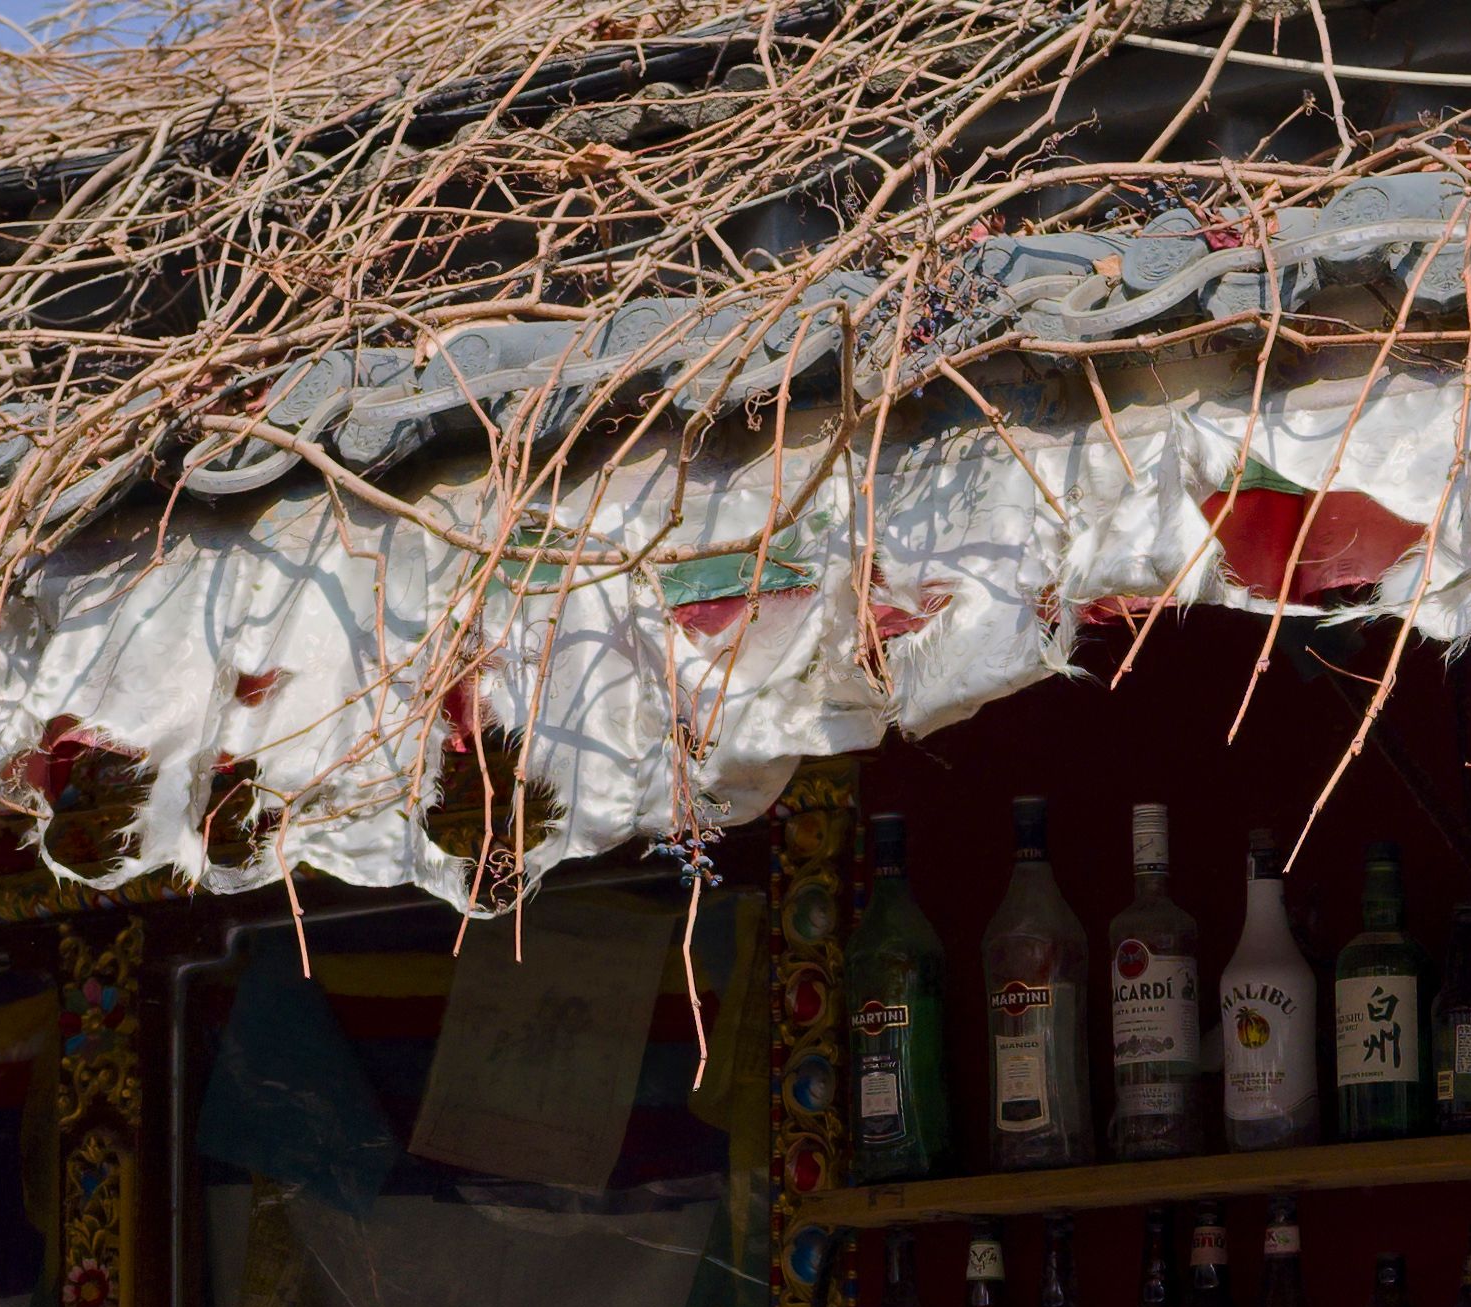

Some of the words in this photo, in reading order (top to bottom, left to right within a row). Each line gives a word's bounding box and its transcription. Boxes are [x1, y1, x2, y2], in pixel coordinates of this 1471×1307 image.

[991, 990, 1047, 1008] MARTINI
[1223, 983, 1298, 1018] MALIBU
[851, 1007, 904, 1027] MARTINI
[1363, 985, 1402, 1069] 白州
